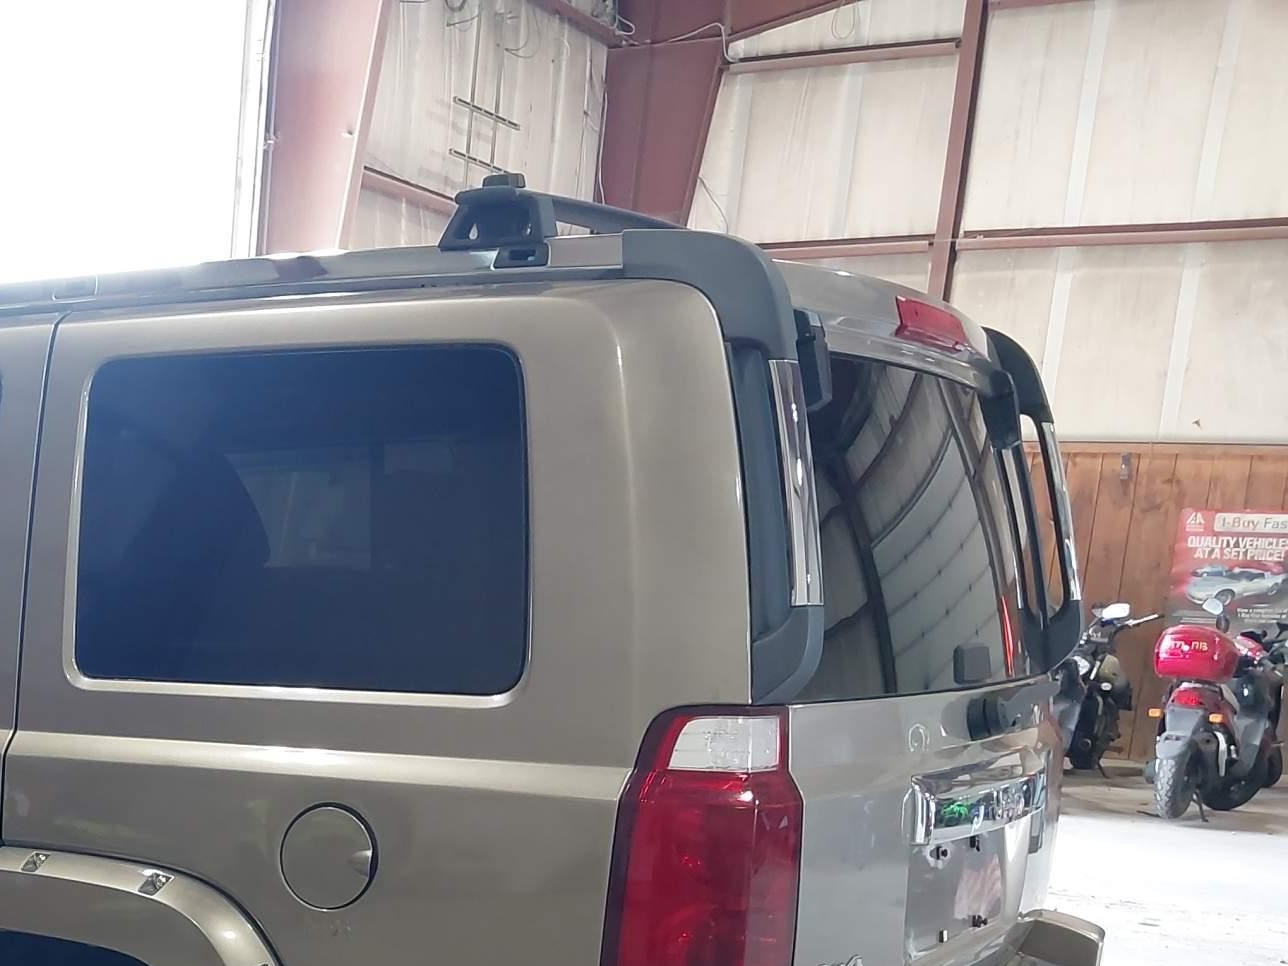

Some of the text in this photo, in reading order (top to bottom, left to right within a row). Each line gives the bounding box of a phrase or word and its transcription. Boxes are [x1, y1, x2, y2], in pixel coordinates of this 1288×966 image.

[1187, 535, 1237, 548] QUALITY
[1194, 547, 1211, 559] AT
[1210, 548, 1221, 559] A
[1222, 548, 1246, 560] SET
